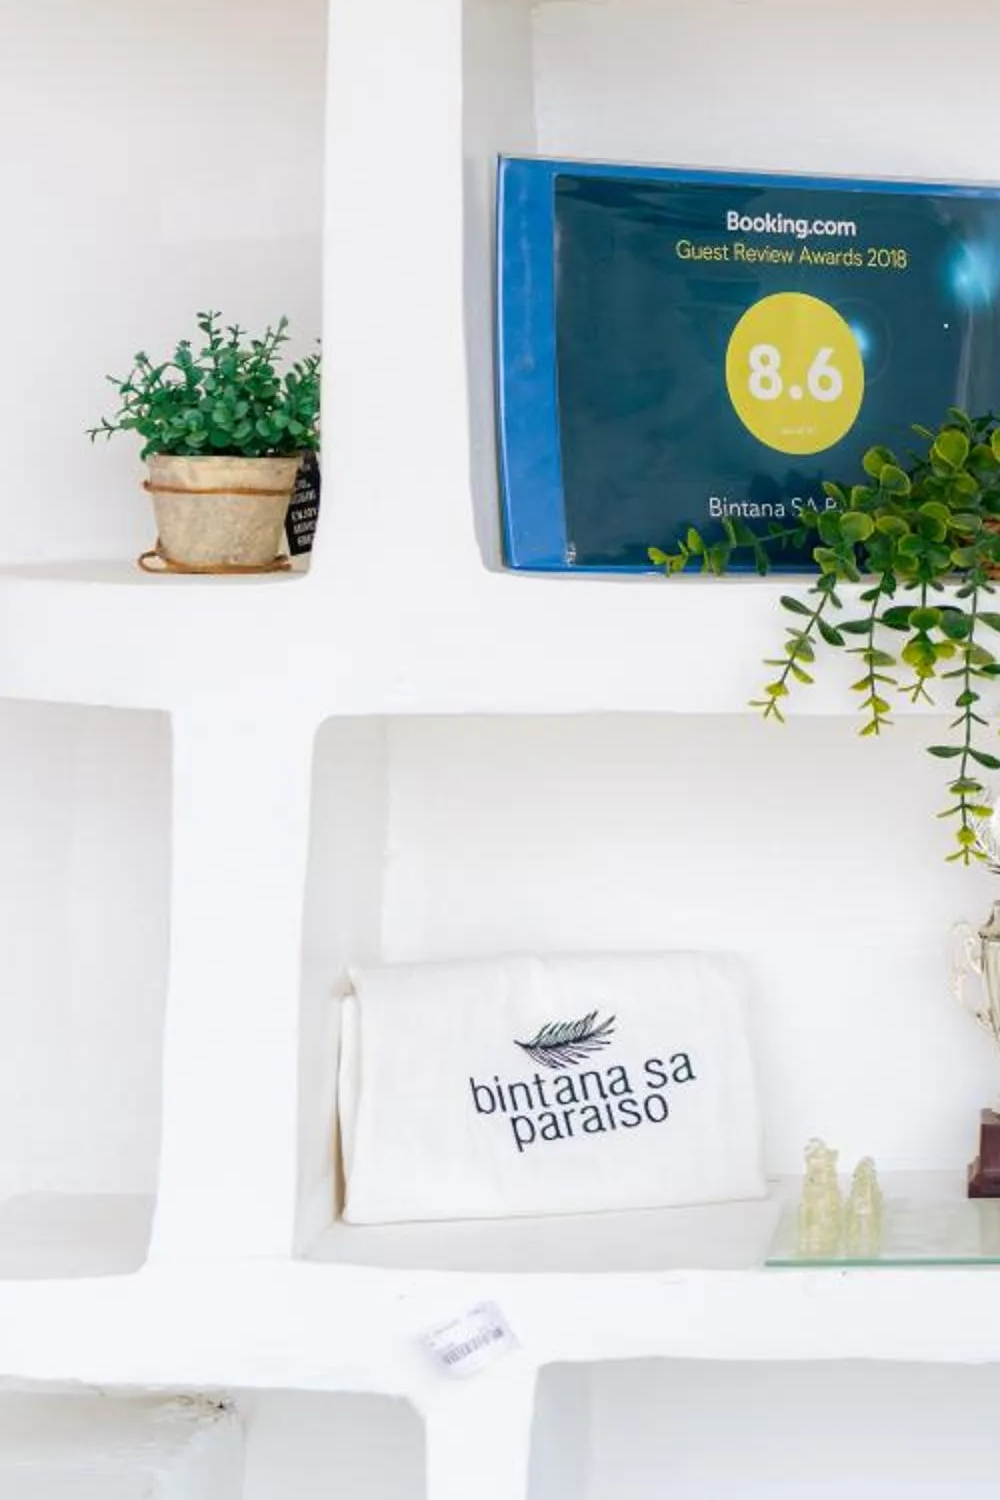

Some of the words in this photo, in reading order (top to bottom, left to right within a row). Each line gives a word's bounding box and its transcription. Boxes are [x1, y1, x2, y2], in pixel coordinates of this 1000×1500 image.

[726, 210, 857, 238] Booking.com
[676, 240, 730, 262] Guest
[734, 244, 795, 265] Review
[799, 247, 863, 268] Awards
[867, 249, 908, 269] 2018
[747, 343, 843, 402] 8.6
[709, 497, 785, 518] Bintana
[791, 496, 819, 516] SA
[470, 1065, 633, 1115] bintana
[644, 1052, 697, 1090] sa
[510, 1093, 669, 1152] paraiso
